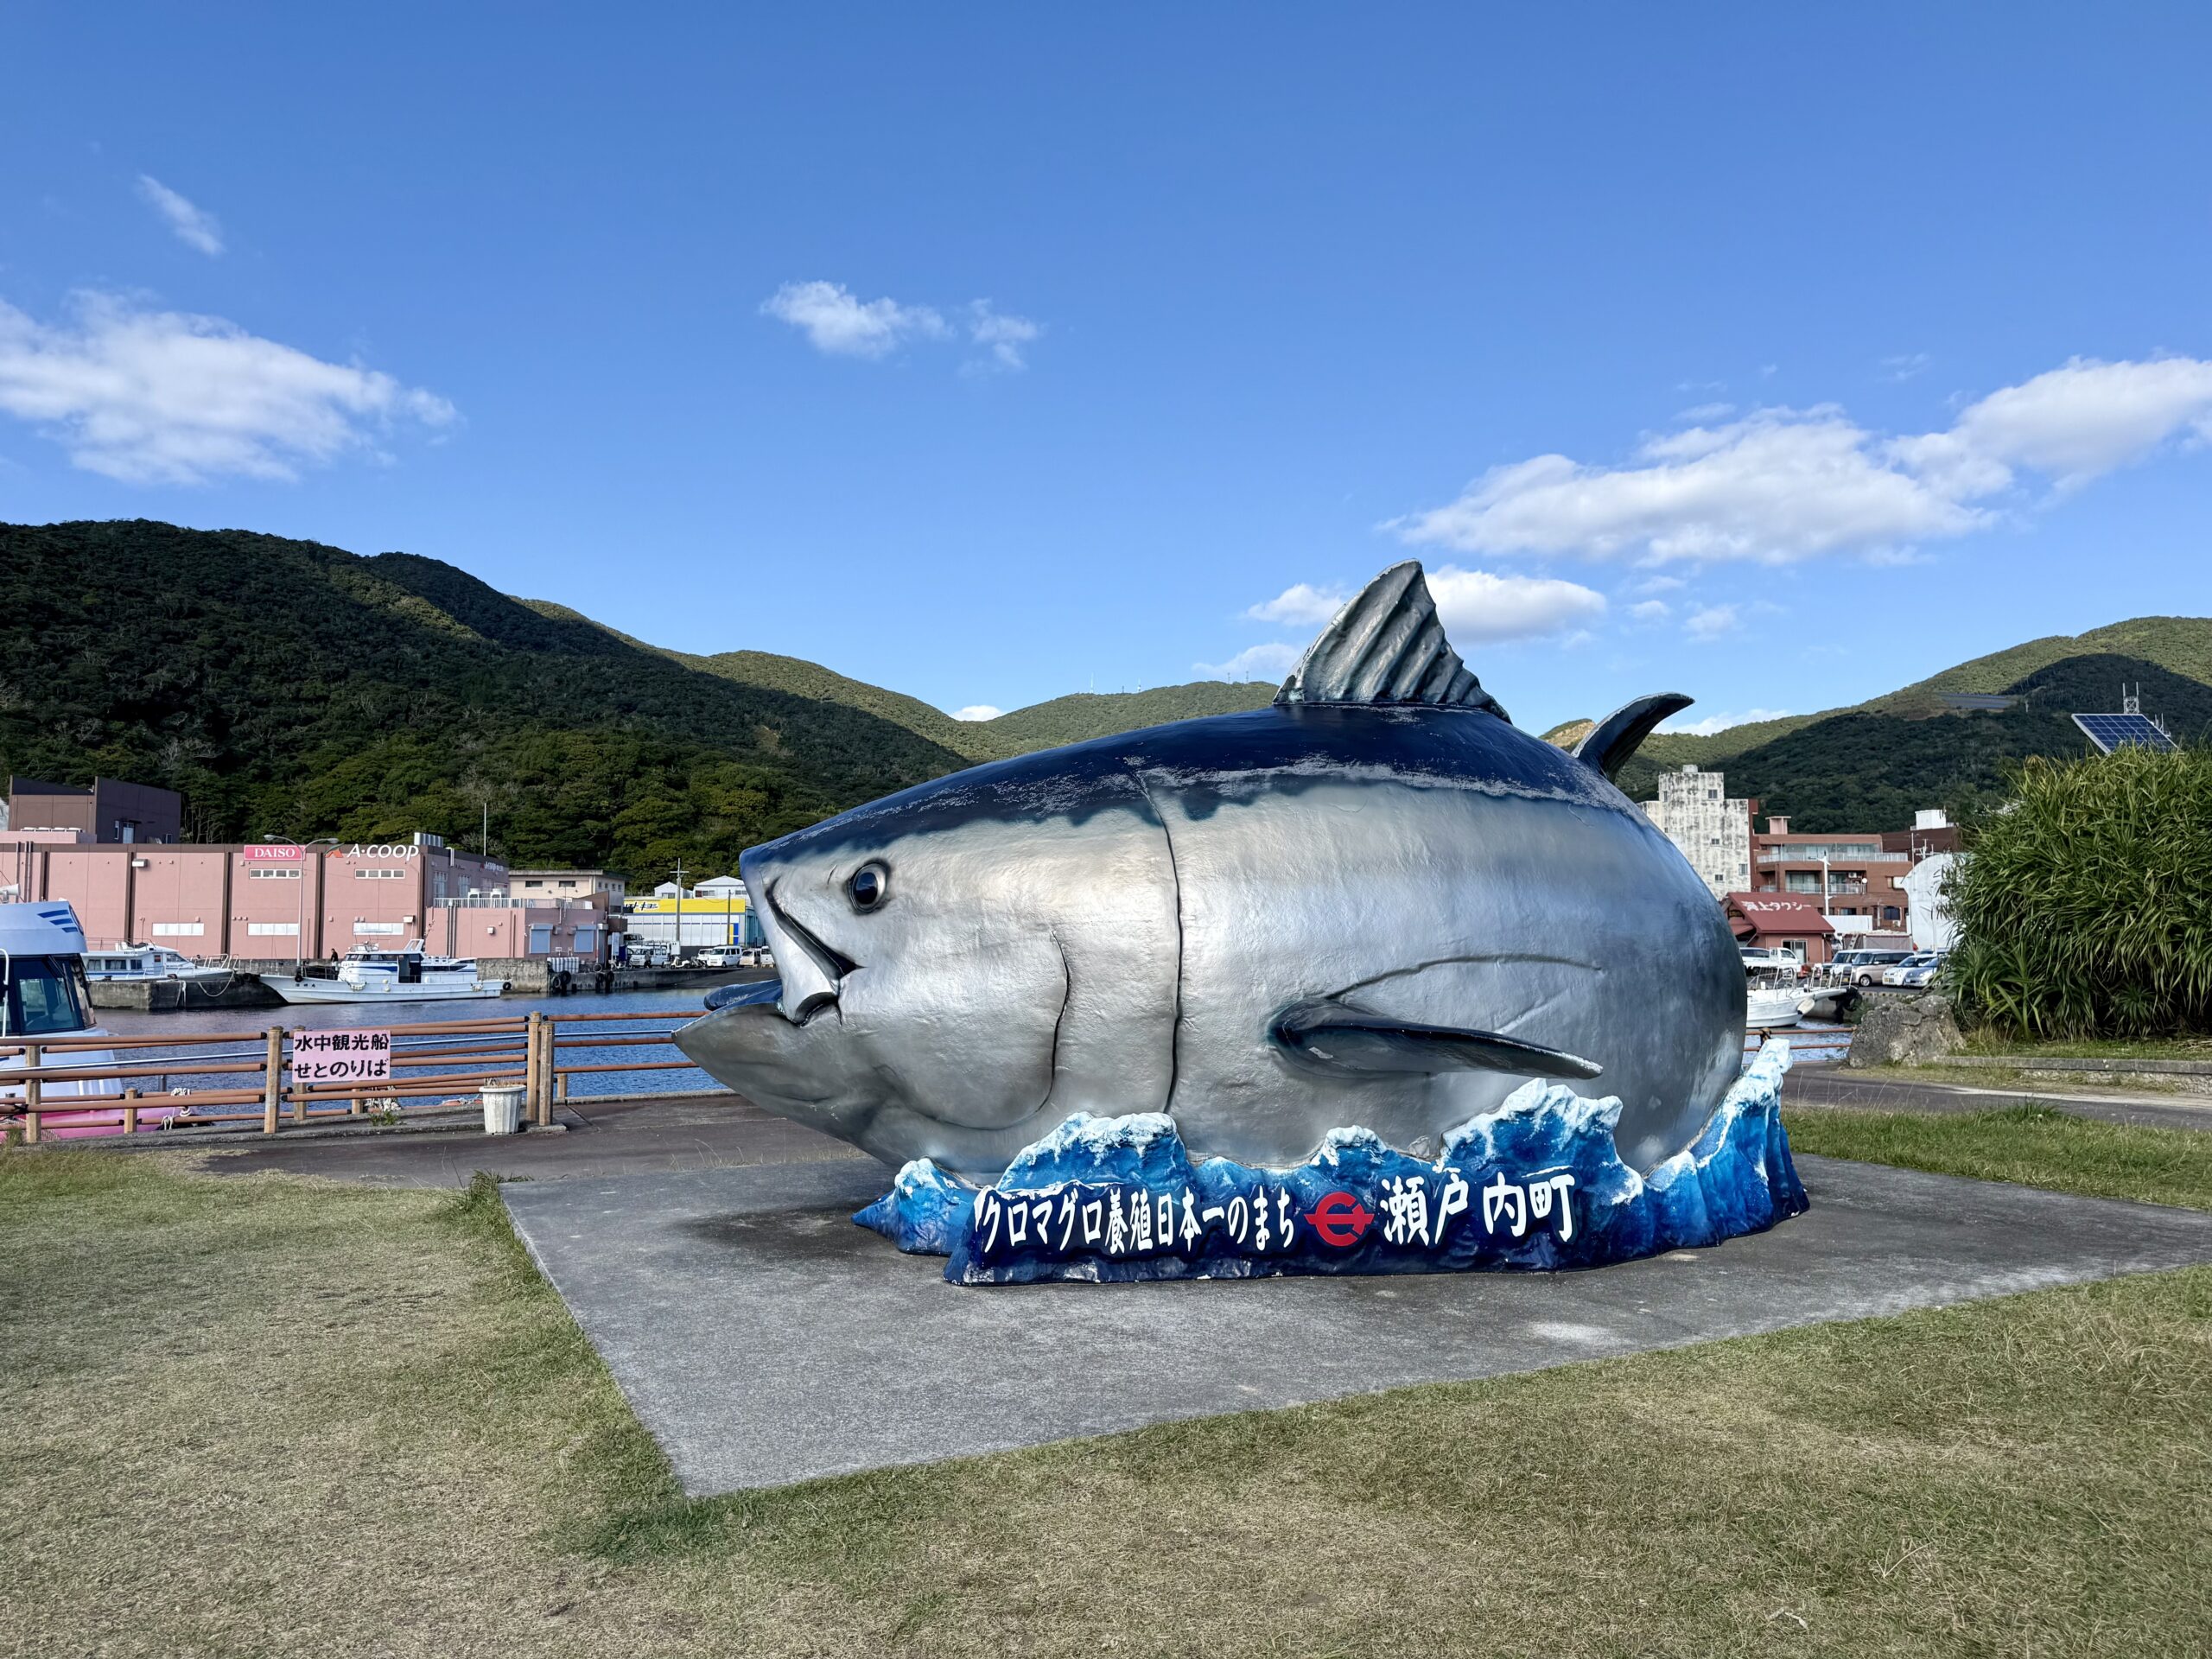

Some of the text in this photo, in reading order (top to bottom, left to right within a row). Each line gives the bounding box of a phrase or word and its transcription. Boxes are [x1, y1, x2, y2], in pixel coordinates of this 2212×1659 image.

[254, 848, 296, 858] DAISO
[294, 1033, 389, 1052] 水中観光船
[294, 1058, 389, 1078] せとのりば
[982, 1172, 1575, 1255] クロマグロ養殖日本一のまち 瀬戸内町
